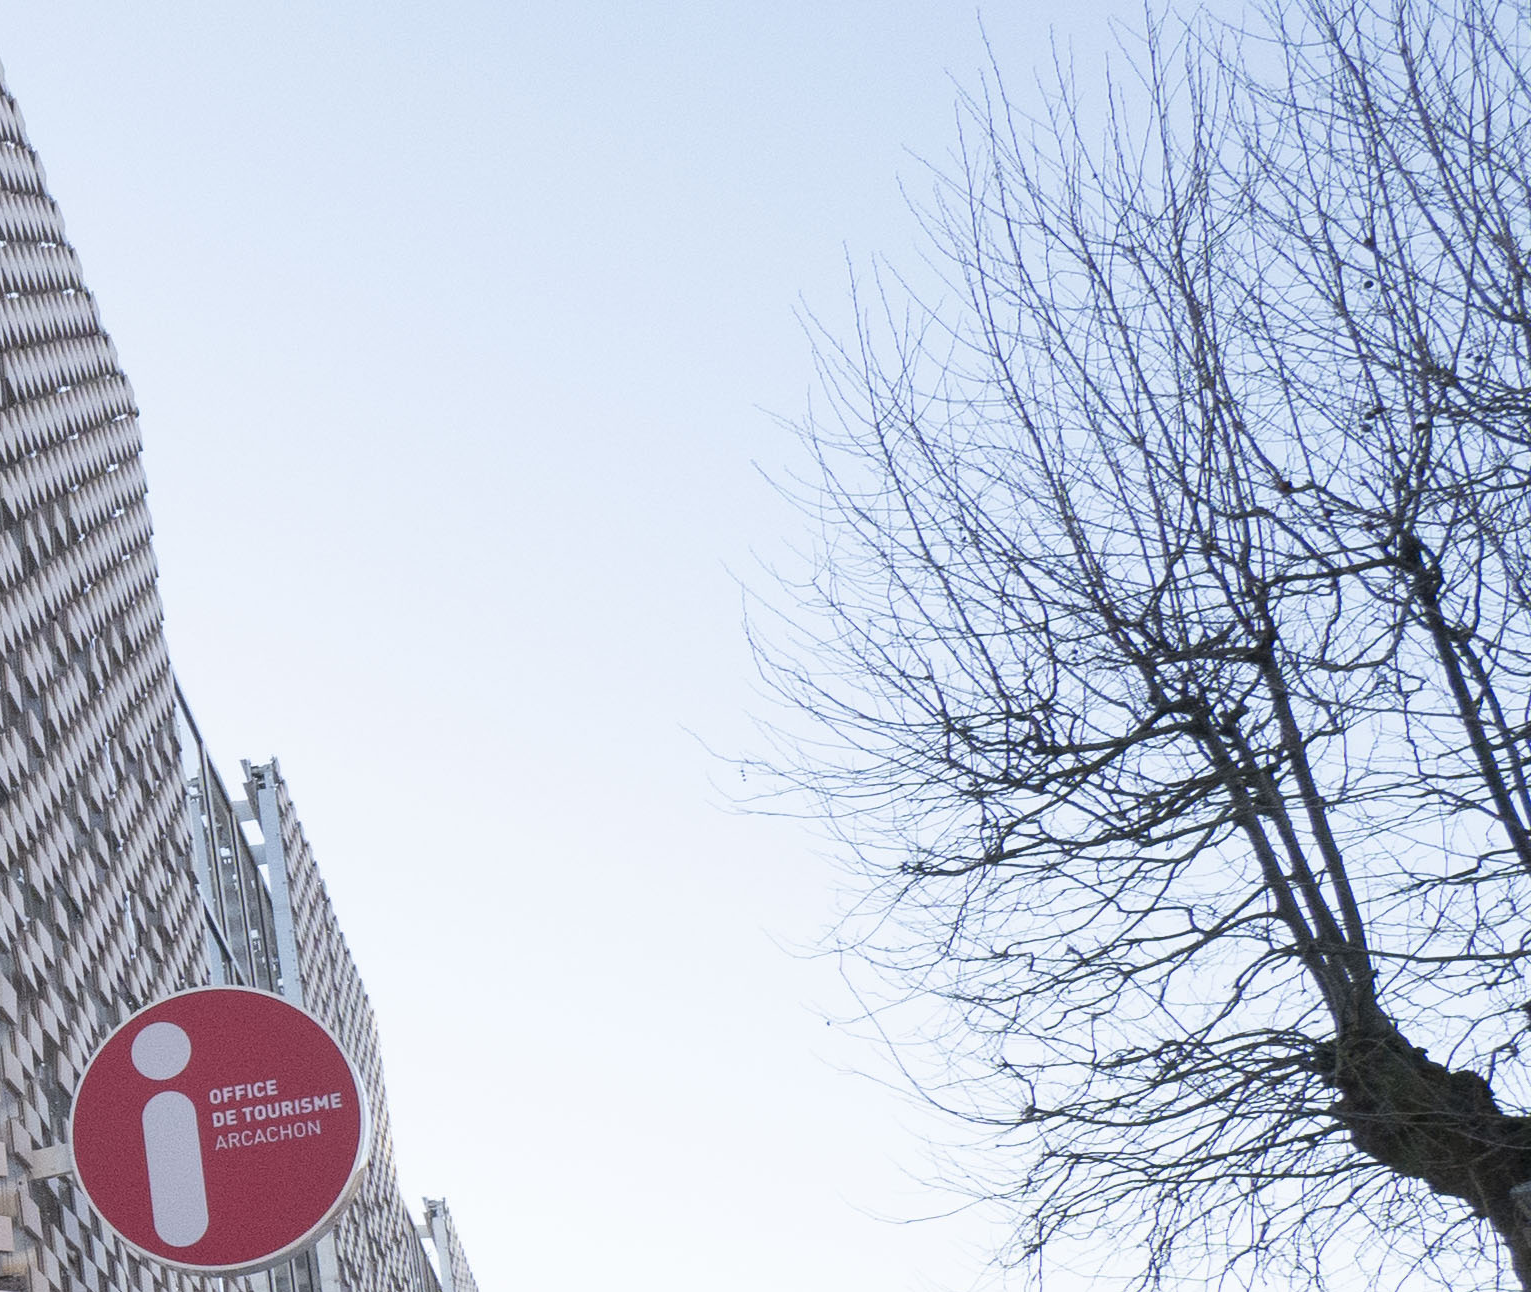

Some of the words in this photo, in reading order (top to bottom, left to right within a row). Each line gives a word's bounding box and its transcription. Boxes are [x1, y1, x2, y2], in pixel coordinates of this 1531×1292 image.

[208, 1079, 278, 1105] OFFICE
[211, 1108, 237, 1129] DE
[242, 1092, 343, 1125] TOURISME
[214, 1120, 322, 1151] ARCACHON
